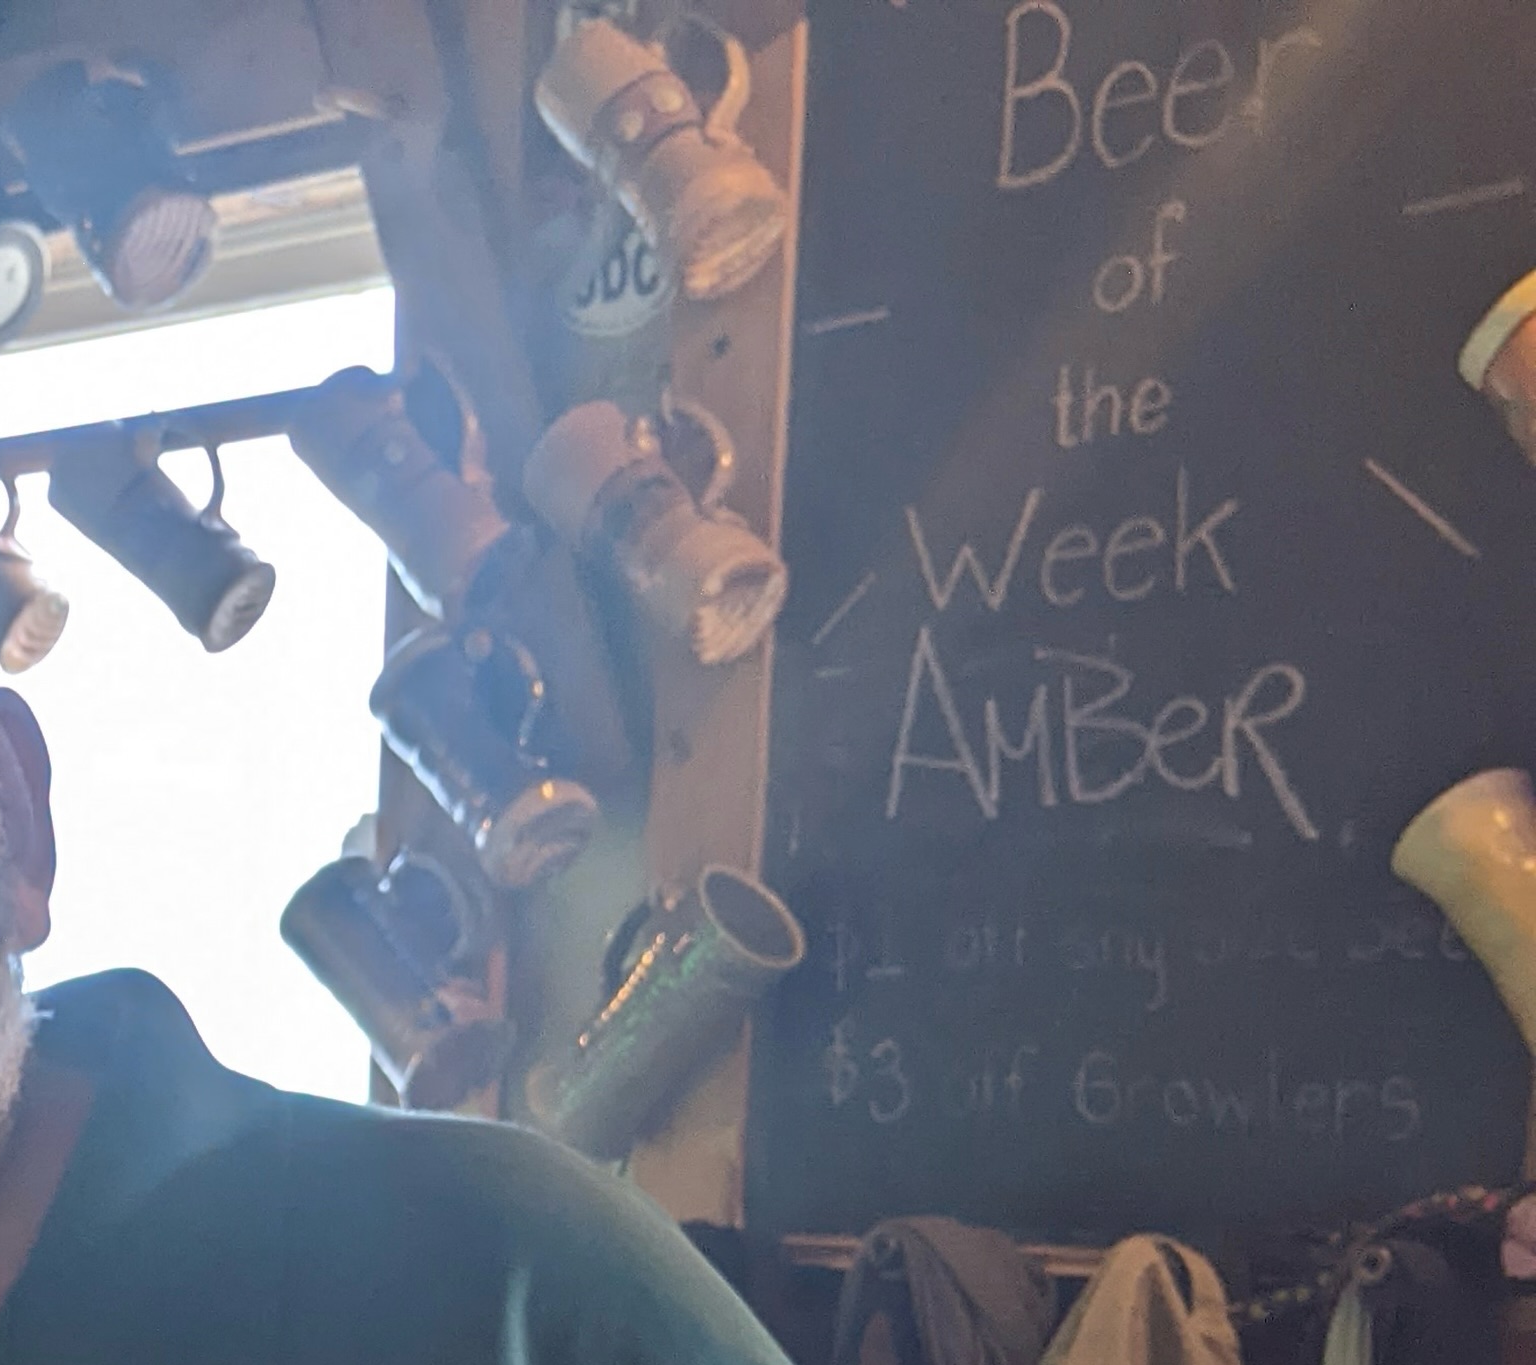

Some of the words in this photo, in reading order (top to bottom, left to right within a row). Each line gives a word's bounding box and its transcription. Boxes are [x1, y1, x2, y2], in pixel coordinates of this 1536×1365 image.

[995, 0, 1322, 190] Beer
[1093, 200, 1186, 314] of
[1052, 364, 1174, 448] the
[906, 465, 1240, 611] Week
